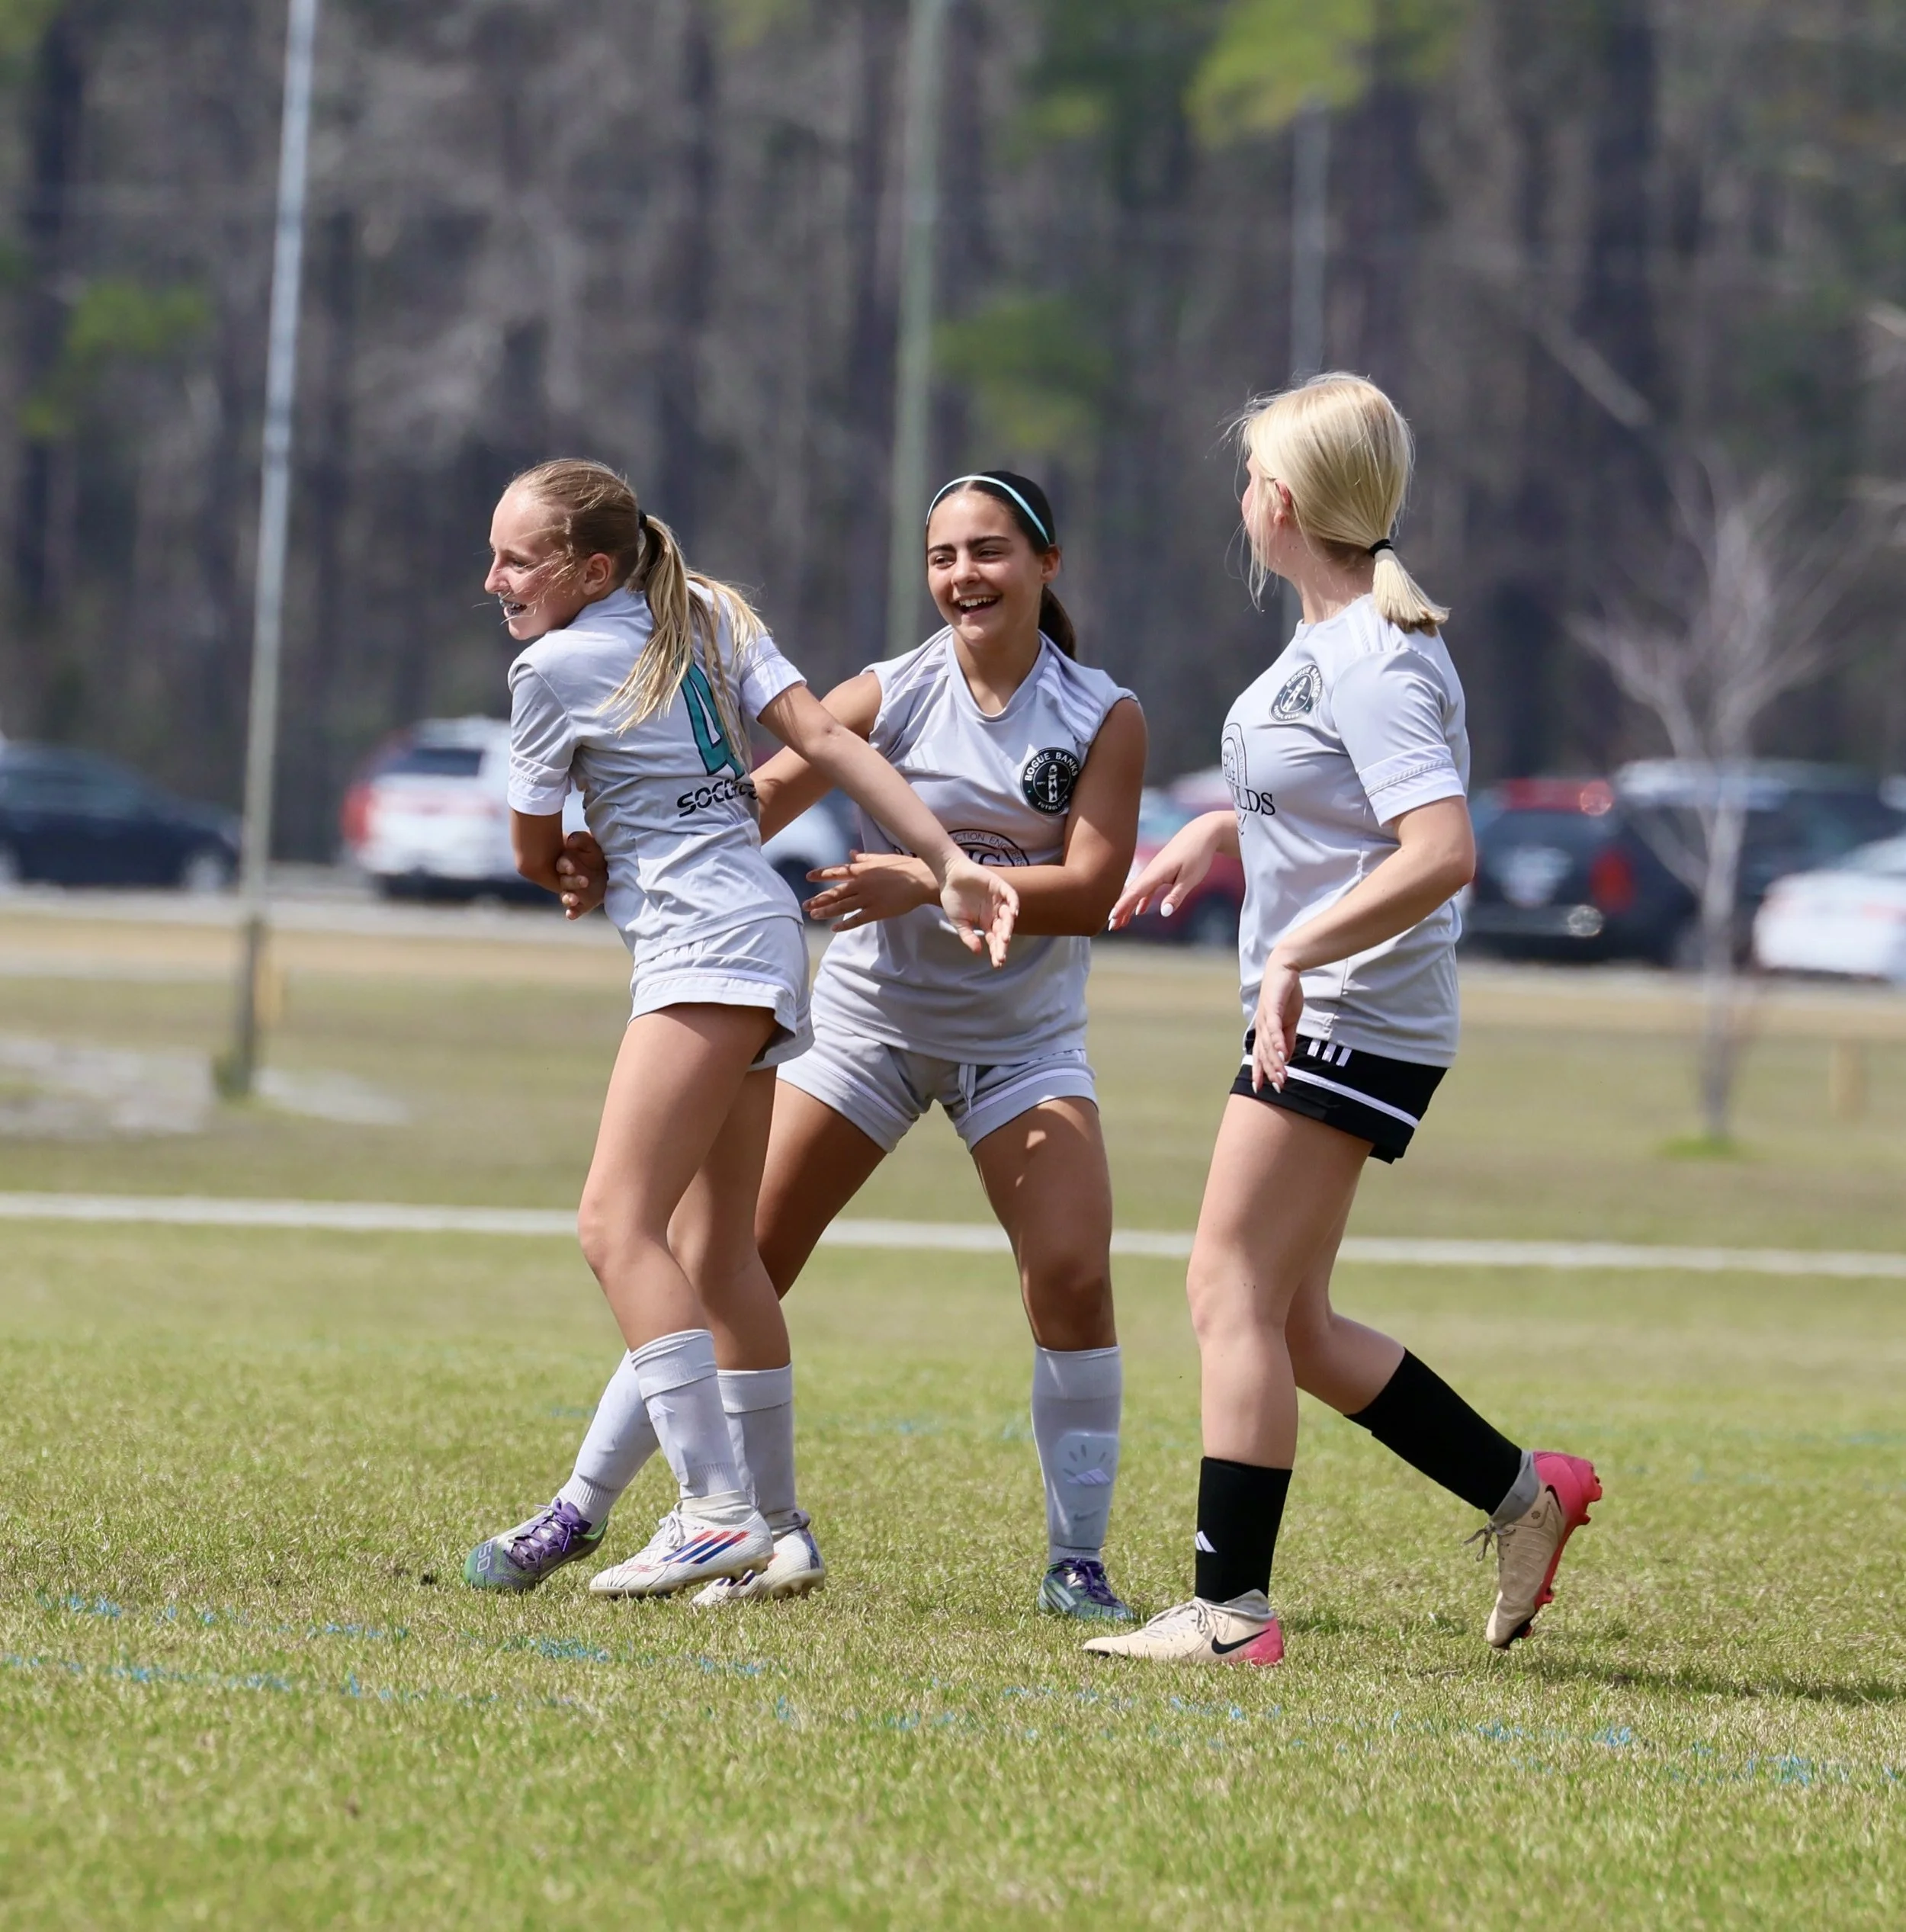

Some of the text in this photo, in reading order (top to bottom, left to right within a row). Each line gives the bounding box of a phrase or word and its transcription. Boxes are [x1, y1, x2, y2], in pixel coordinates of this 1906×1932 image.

[1311, 667, 1321, 698] BANKS
[673, 644, 746, 781] 4
[1024, 752, 1079, 781] BOGUE BANKS
[951, 832, 986, 843] CTION
